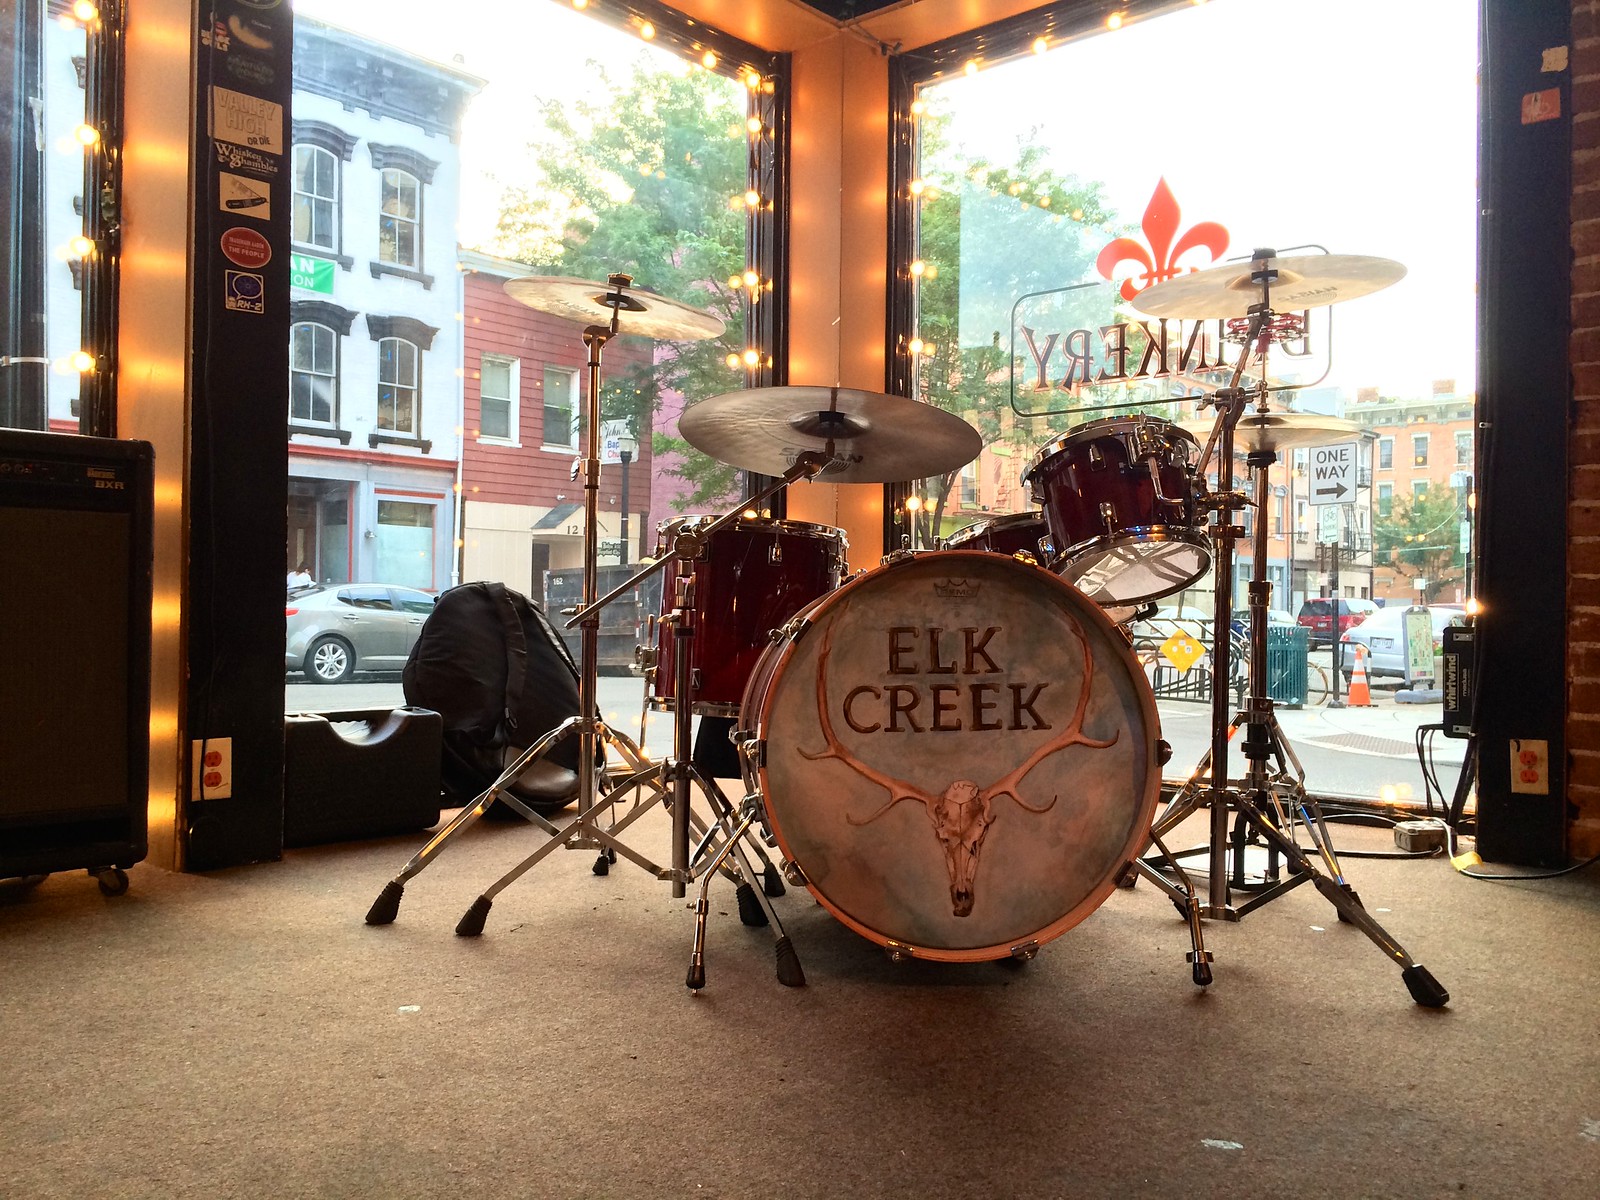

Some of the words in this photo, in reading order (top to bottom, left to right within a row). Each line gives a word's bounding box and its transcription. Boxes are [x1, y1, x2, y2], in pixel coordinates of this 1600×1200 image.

[218, 91, 276, 121] VALLEY
[226, 109, 266, 136] HIGH
[214, 141, 262, 161] Whiskey
[247, 136, 258, 146] OR
[228, 246, 240, 254] THE
[241, 249, 265, 259] PEOPLE
[1316, 448, 1349, 464] ONE
[1315, 464, 1350, 480] WAY
[886, 626, 1004, 675] ELK
[1445, 655, 1457, 710] whirlwind
[842, 683, 1053, 734] CREEK
